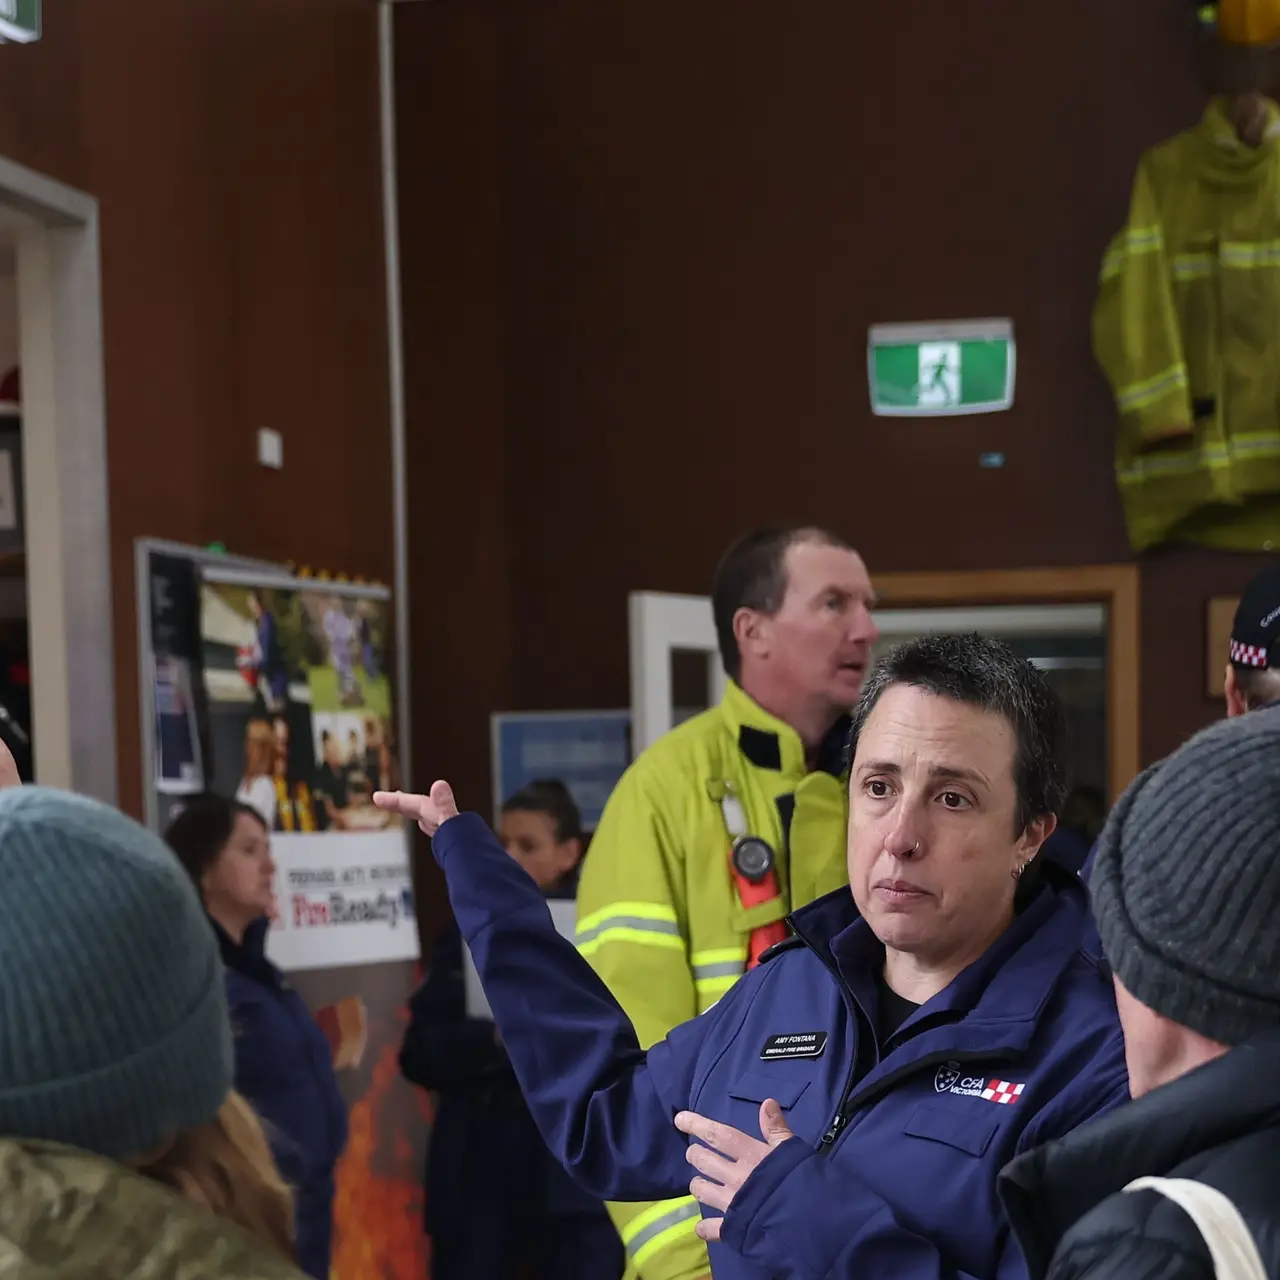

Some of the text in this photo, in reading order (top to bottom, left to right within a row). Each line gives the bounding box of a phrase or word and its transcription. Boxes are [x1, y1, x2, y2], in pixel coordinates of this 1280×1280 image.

[775, 1034, 816, 1045] AMY FONTANA
[961, 1078, 985, 1089] CFA
[950, 1085, 982, 1097] VICTORIA
